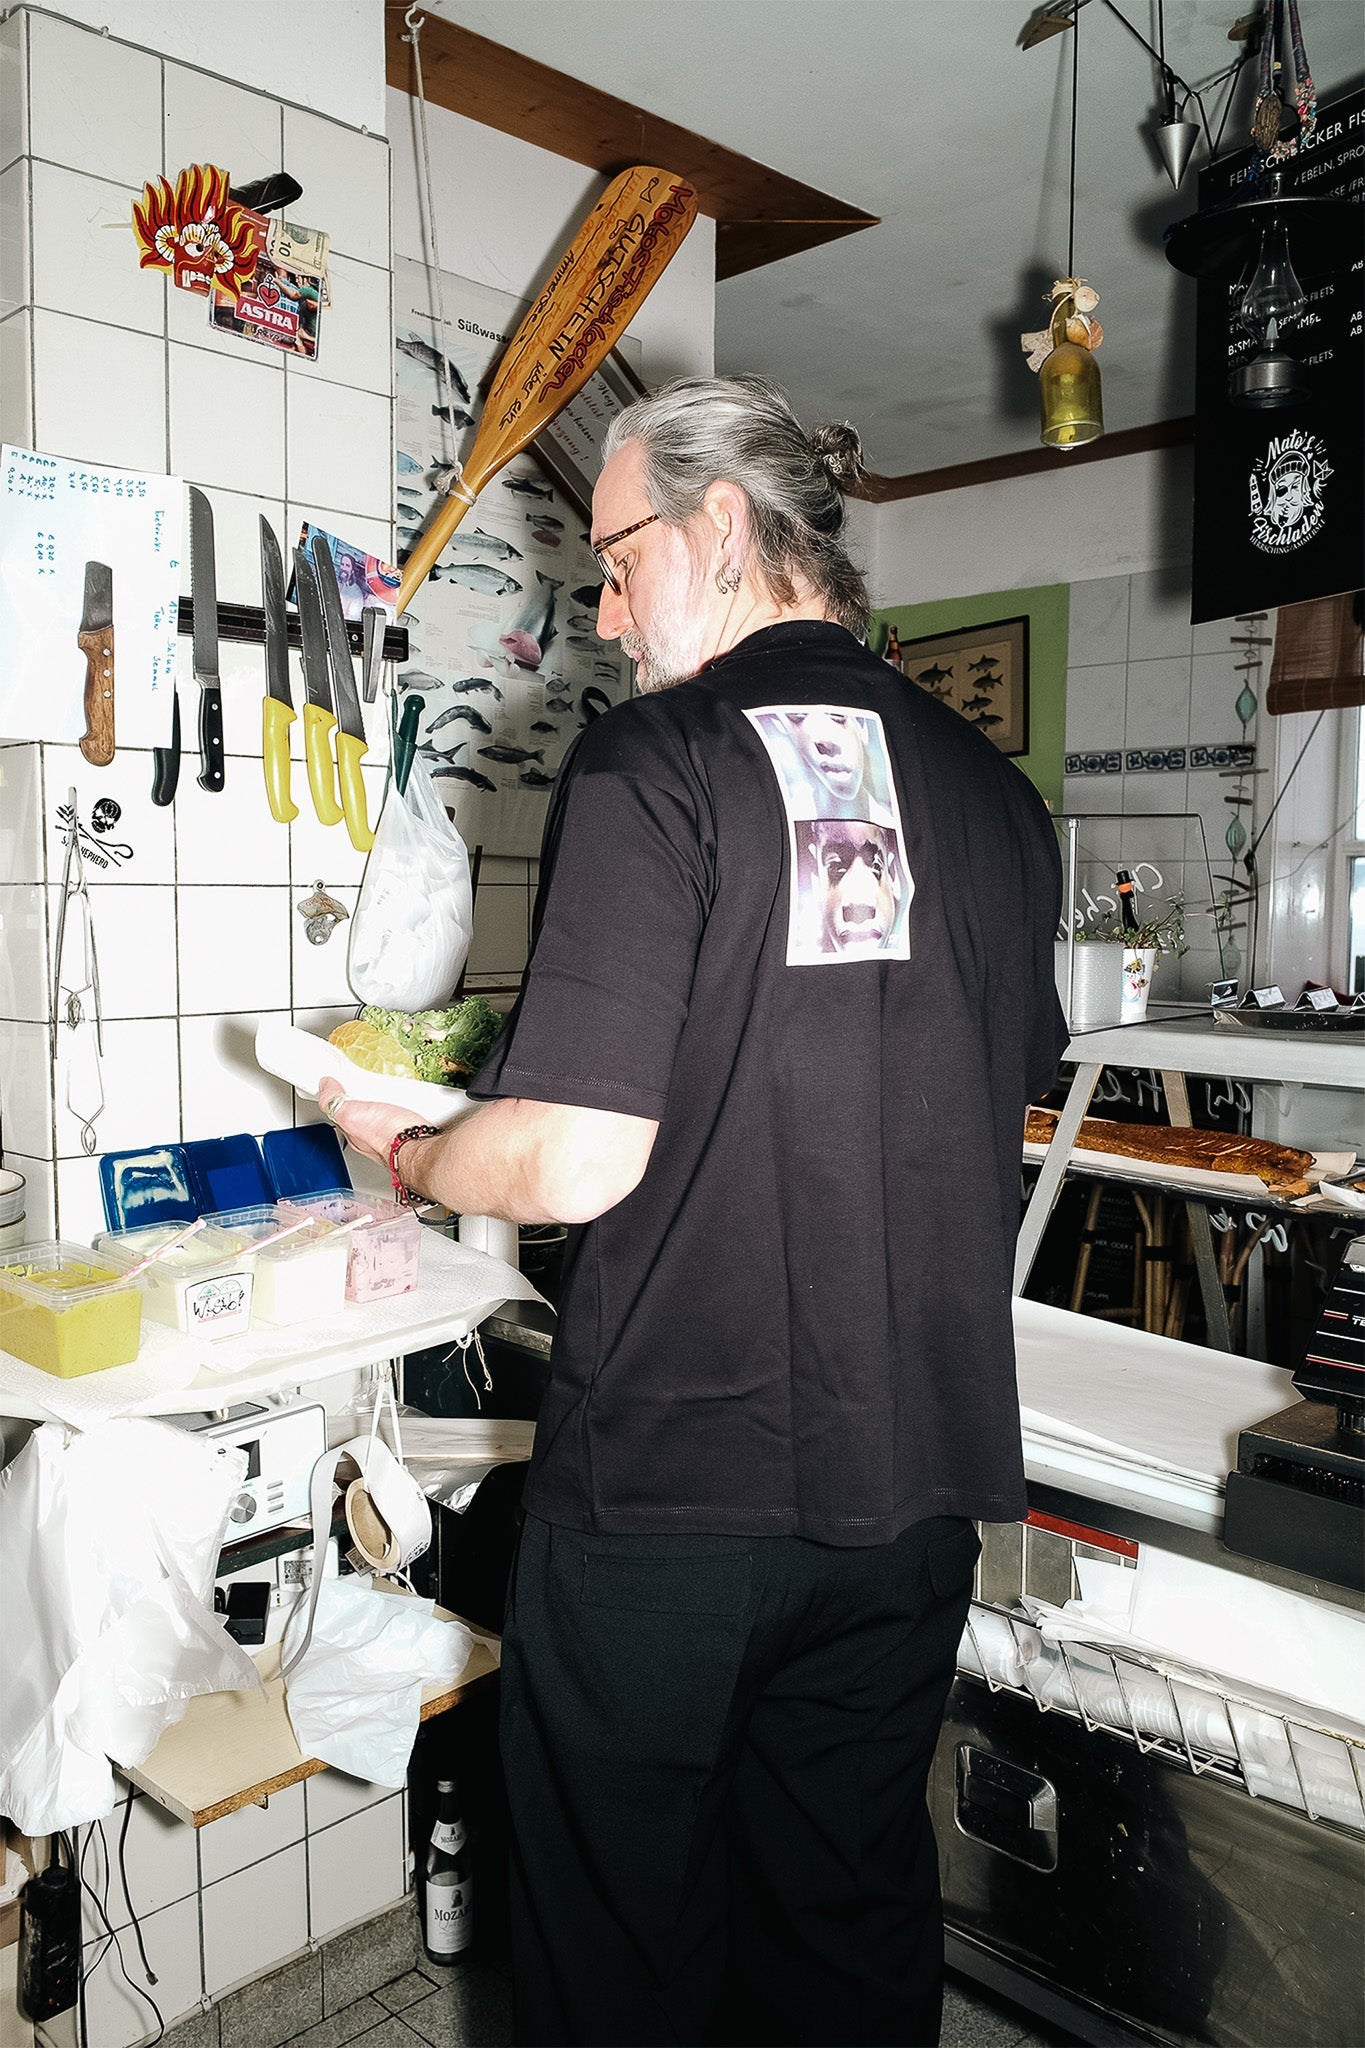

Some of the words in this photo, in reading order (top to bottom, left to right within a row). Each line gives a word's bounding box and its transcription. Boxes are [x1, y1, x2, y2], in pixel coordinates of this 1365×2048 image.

[278, 240, 292, 257] 10
[530, 249, 576, 324] Ammersee
[548, 212, 645, 361] GUTSCHEIN
[240, 302, 293, 330] ASTRA
[1349, 310, 1363, 323] AB
[1349, 324, 1363, 337] AB
[539, 266, 645, 403] Fischladen
[1228, 338, 1258, 356] BISMA
[520, 360, 549, 398] über
[499, 397, 524, 431] ein
[574, 416, 597, 446] keine
[1264, 428, 1316, 469] Mato's
[1252, 500, 1325, 546] Fischladen
[80, 846, 109, 869] HEPHERD
[434, 1904, 470, 1921] MOZAR
